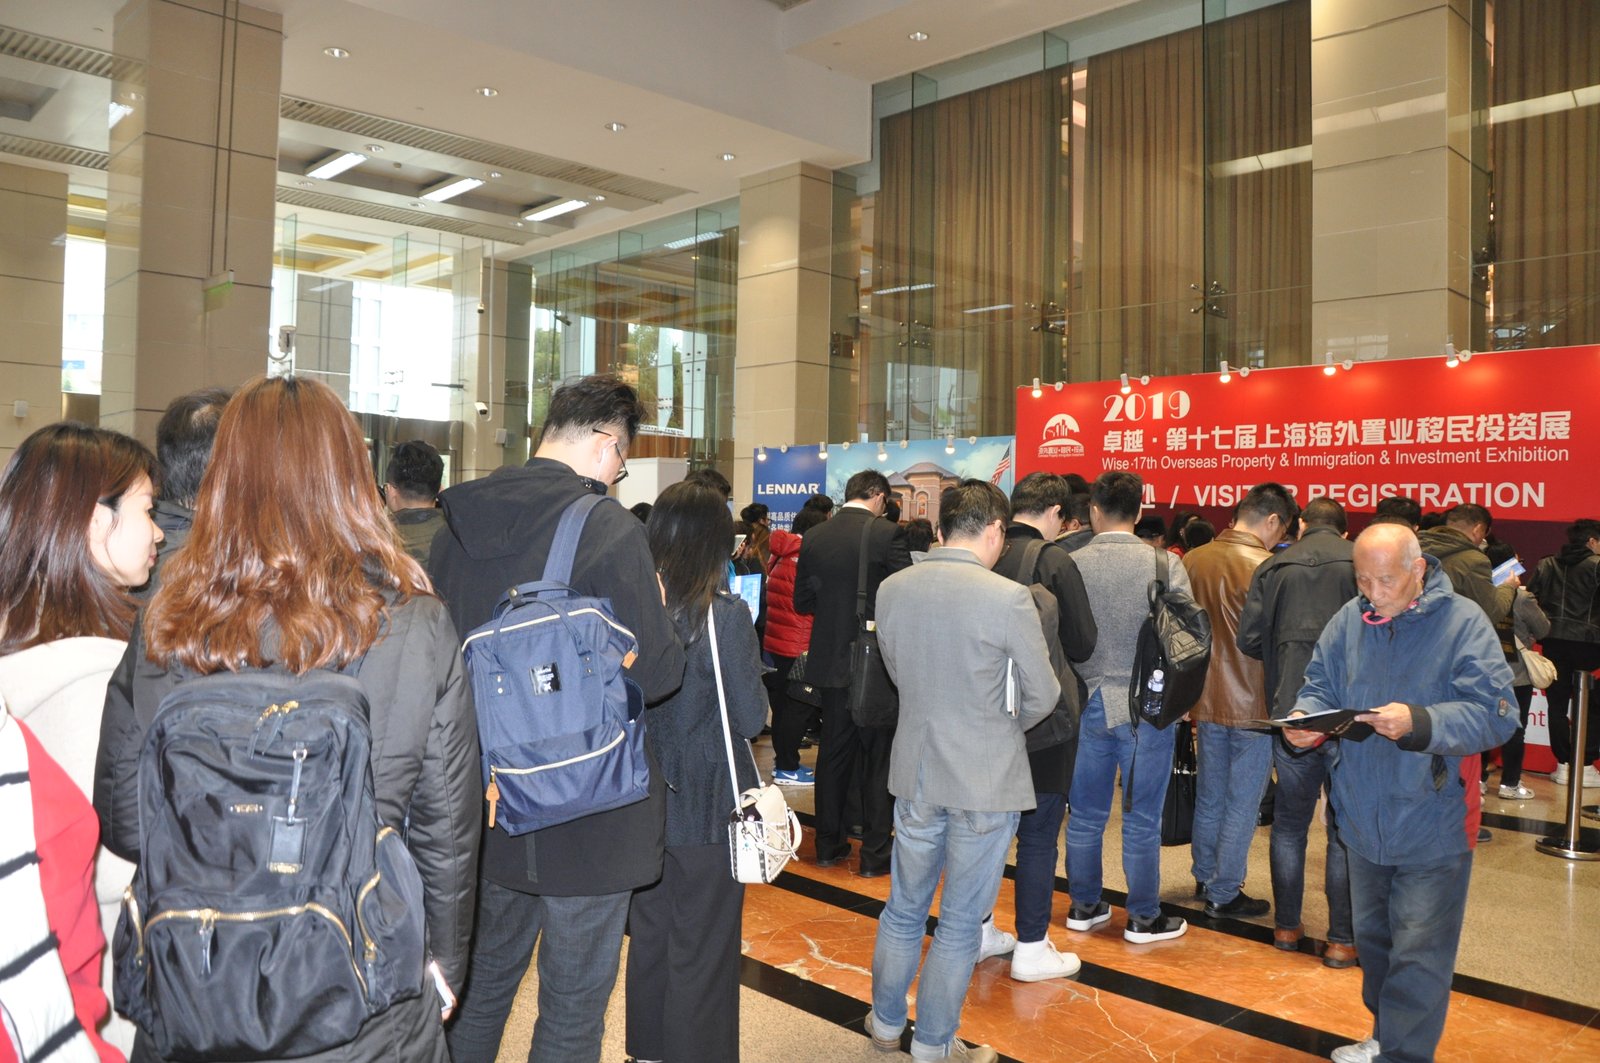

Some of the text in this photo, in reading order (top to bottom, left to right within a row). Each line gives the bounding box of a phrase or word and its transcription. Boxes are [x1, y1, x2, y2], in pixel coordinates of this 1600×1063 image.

[1103, 390, 1191, 422] 2019
[1160, 455, 1218, 469] Overseas
[1221, 453, 1276, 471] Property
[1279, 453, 1290, 467] &
[1294, 451, 1375, 470] Immigration
[1379, 450, 1391, 465] &
[1395, 449, 1481, 464] Investment
[1486, 447, 1569, 463] Exhibition
[757, 483, 819, 494] LENNAR
[1193, 484, 1299, 508] VISI
[1307, 482, 1545, 508] REGISTRATION
